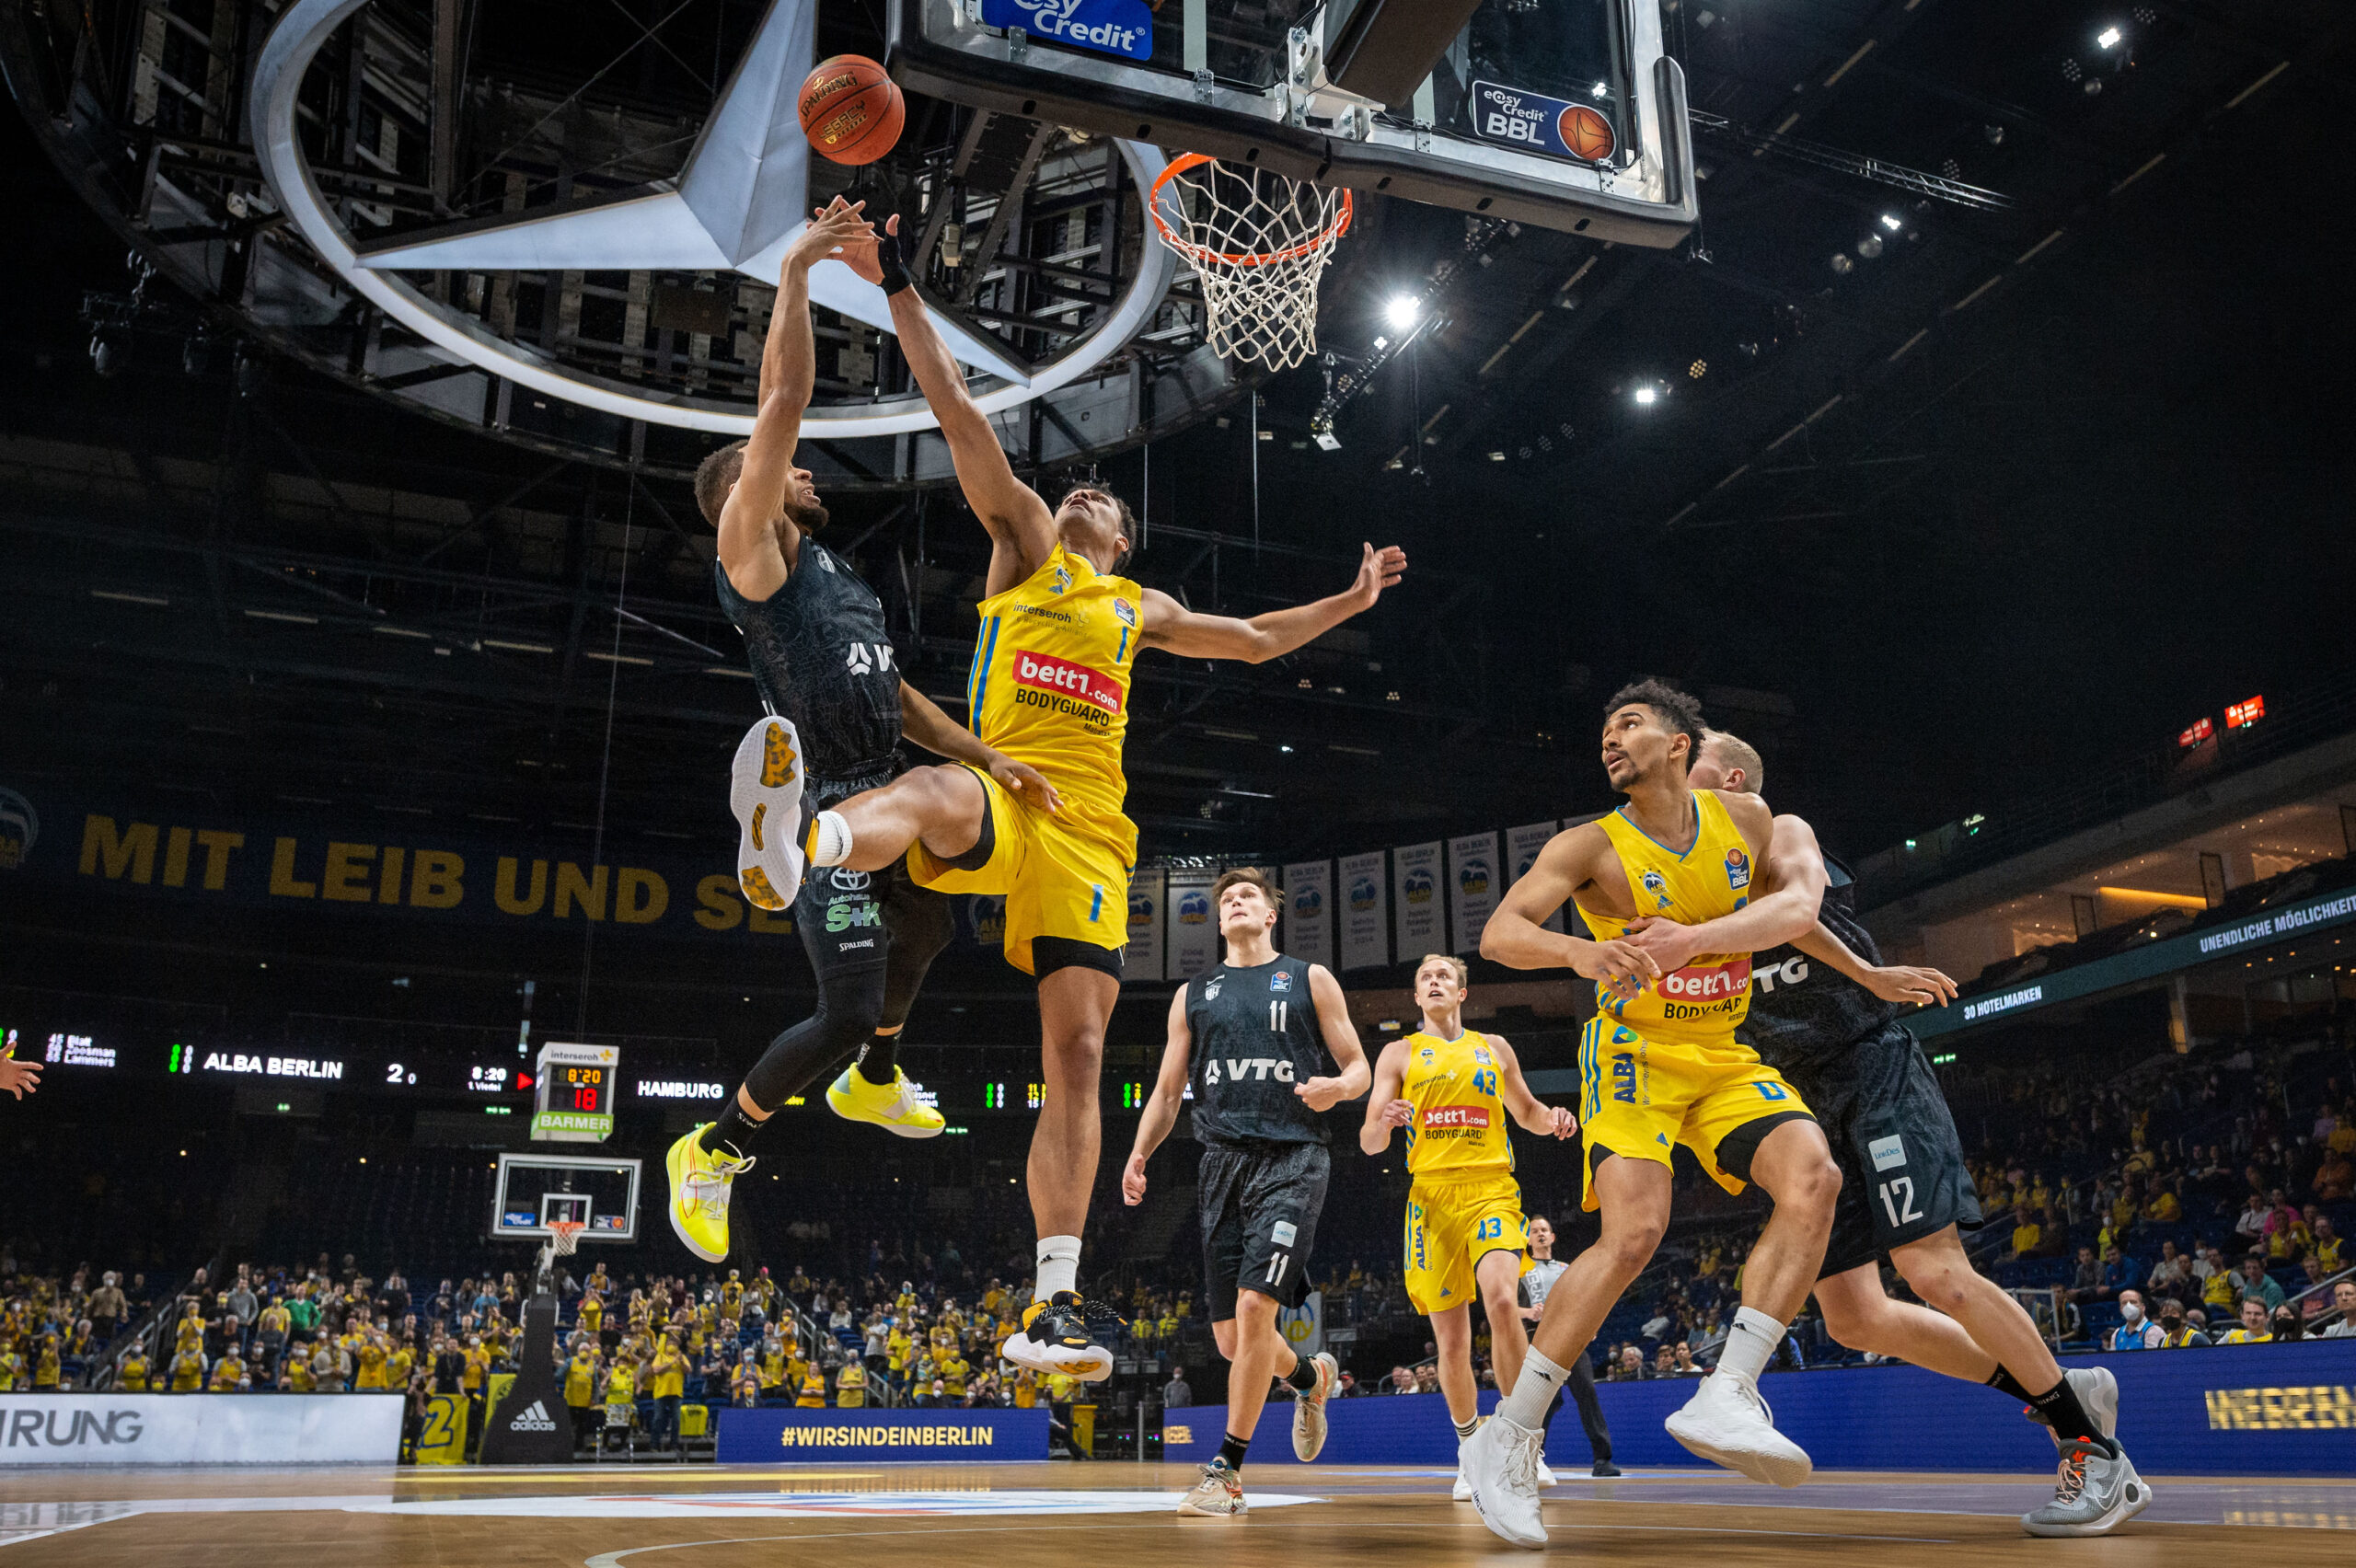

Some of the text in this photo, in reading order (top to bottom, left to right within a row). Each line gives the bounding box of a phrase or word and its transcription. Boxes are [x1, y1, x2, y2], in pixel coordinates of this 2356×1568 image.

[801, 71, 858, 121] SPALDING
[1502, 103, 1545, 122] Credit
[1486, 111, 1545, 145] BBL
[1013, 601, 1072, 623] interseroh
[1015, 688, 1110, 727] BODYGUARD
[77, 813, 245, 891] MIT
[269, 836, 466, 908] LEIB
[494, 856, 670, 924] UND
[1732, 874, 1749, 887] BBL
[839, 939, 874, 952] SPALDING
[2200, 919, 2272, 953] UNENDLICHE
[1752, 954, 1808, 994] TG
[1964, 986, 2042, 1020] 30 HOTELMARKEN
[1269, 1000, 1288, 1032] 11
[203, 1053, 263, 1074] ALBA
[266, 1057, 343, 1079] BERLIN
[550, 1050, 599, 1061] interseroh
[387, 1063, 404, 1083] 2
[1226, 1058, 1295, 1083] VTG
[1472, 1067, 1496, 1097] 43
[574, 1088, 598, 1111] 18
[638, 1080, 724, 1099] HAMBURG
[540, 1114, 610, 1131] BARMER
[1425, 1128, 1483, 1140] BODYGUARD
[1879, 1176, 1924, 1228] 12
[1415, 1225, 1426, 1272] ALBA
[1265, 1251, 1289, 1287] 11
[510, 1420, 557, 1432] adidas
[781, 1425, 993, 1447] #WIRSINDEINBERLIN
